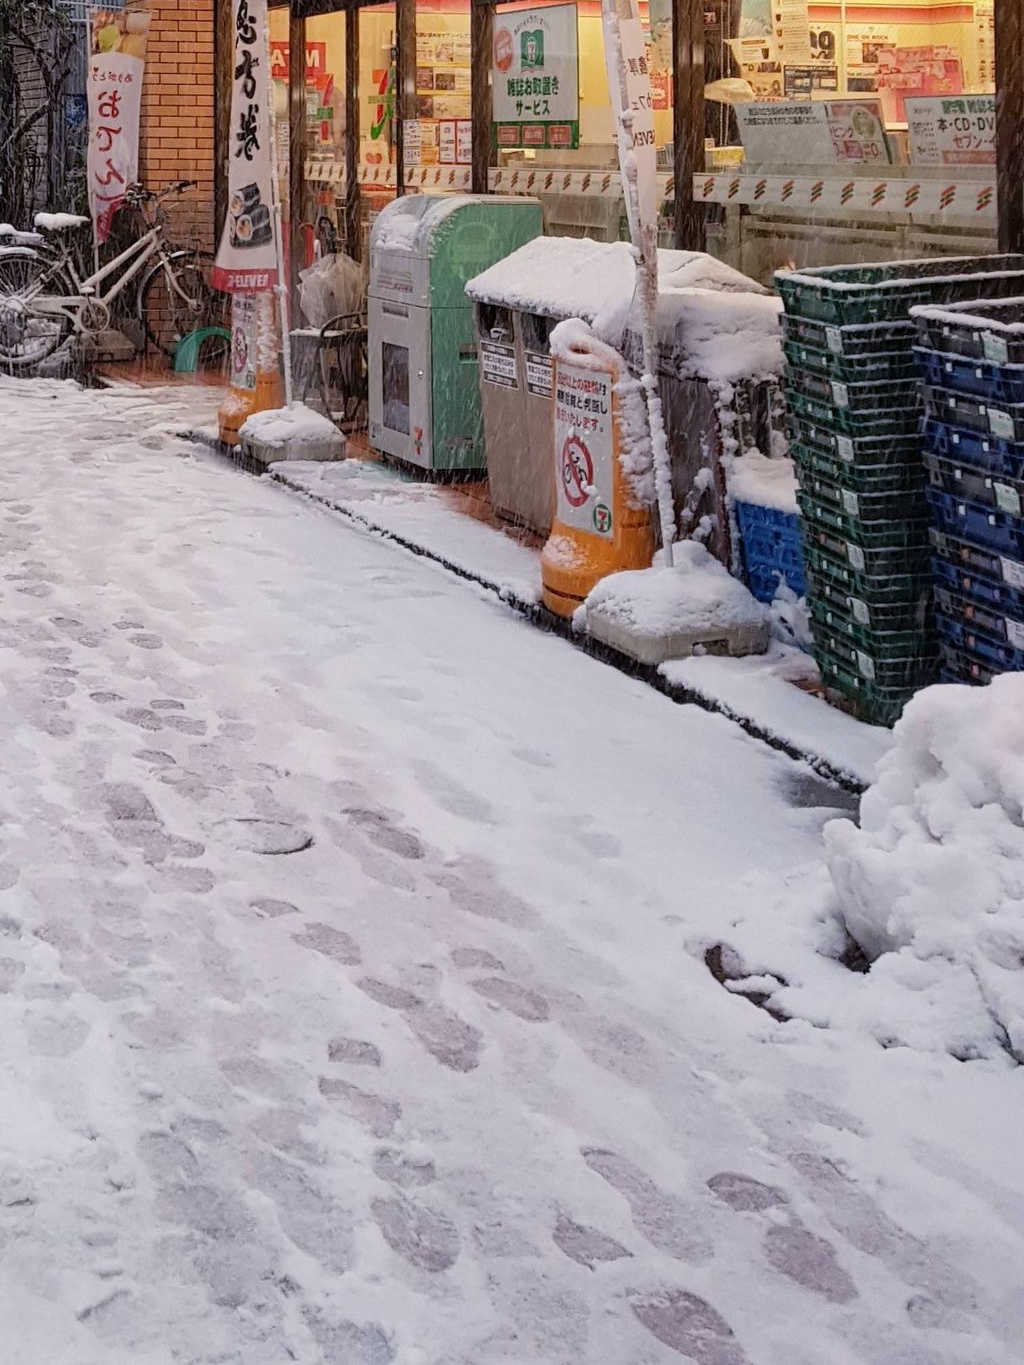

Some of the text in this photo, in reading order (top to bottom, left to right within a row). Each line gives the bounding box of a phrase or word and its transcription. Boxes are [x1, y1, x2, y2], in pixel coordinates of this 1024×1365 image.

[507, 76, 560, 96] 雑誌お取置き
[515, 99, 551, 116] サービス
